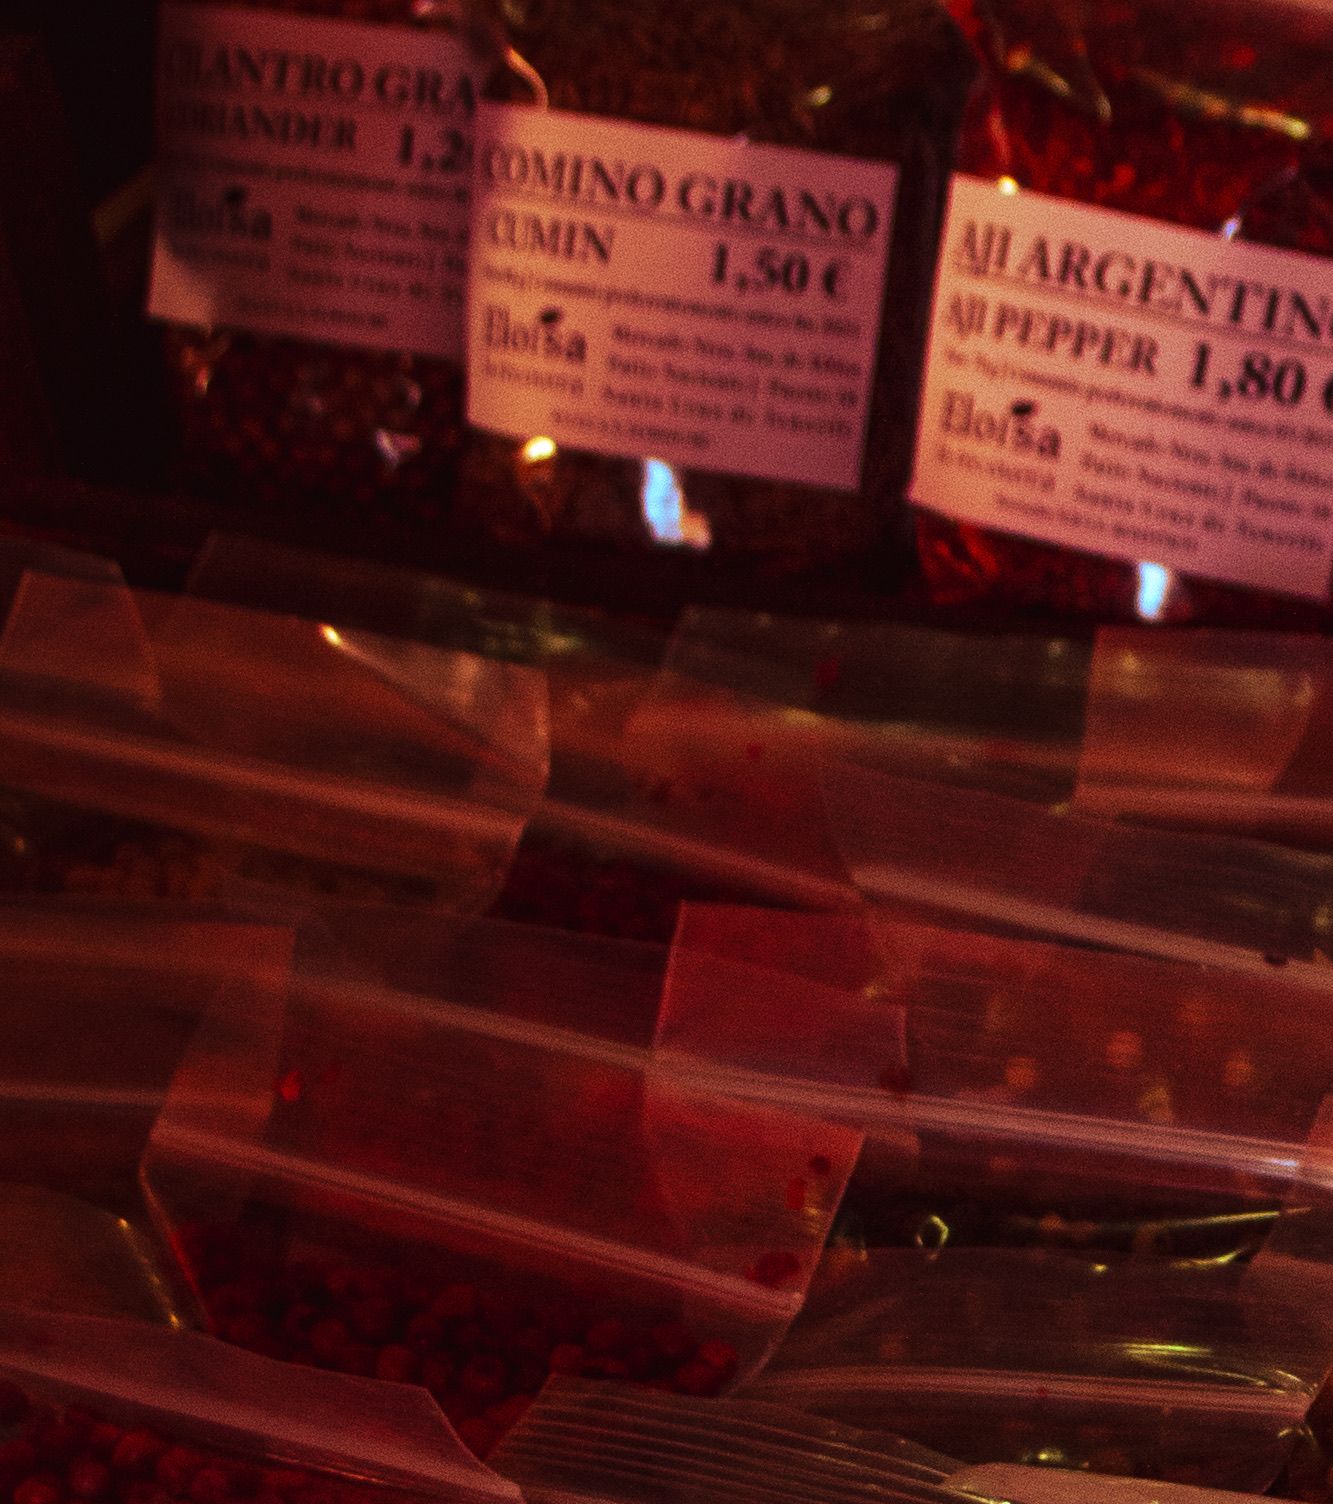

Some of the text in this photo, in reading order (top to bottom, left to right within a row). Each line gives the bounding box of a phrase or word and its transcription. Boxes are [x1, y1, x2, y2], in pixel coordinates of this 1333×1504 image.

[373, 62, 474, 112] GRA
[482, 138, 880, 241] COMINO GRANO
[489, 208, 616, 266] CUMIN
[710, 241, 812, 297] 1,50
[993, 298, 1161, 378] PEPPER
[1188, 338, 1310, 411] 1,80
